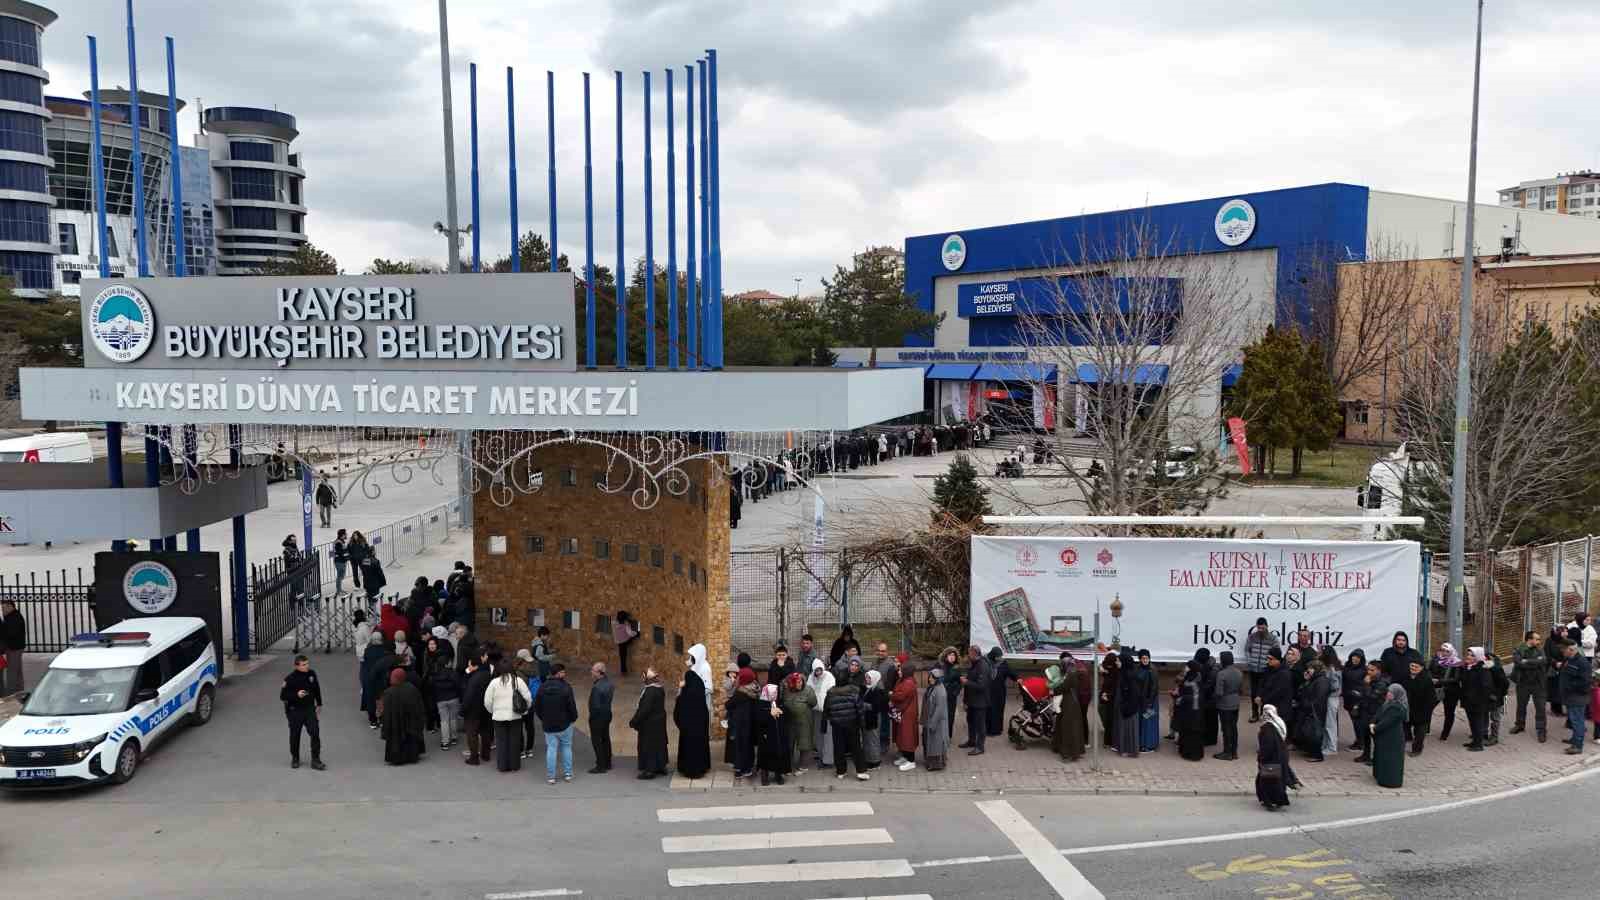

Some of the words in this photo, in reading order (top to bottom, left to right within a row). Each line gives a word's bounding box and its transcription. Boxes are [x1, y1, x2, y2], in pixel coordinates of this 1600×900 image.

[277, 287, 416, 321] KAYSERİ
[164, 325, 366, 367] BÜYÜKŞEHİR
[376, 325, 563, 361] BELEDİYESİ
[115, 377, 228, 410] KAYSERİ
[236, 376, 342, 413] DÜNYA
[353, 378, 477, 414] TİCARET
[487, 379, 638, 416] MERKEZİ
[1209, 551, 1271, 570] KUTSAL
[1292, 552, 1338, 570] VAKIF
[1169, 569, 1270, 588] EMANETLER
[1275, 565, 1288, 576] VE
[1291, 570, 1372, 590] ESERLERİ
[1229, 591, 1306, 610] SERGİSİ
[1193, 624, 1237, 649] Hoş
[1248, 621, 1344, 647] ldniz
[150, 703, 169, 728] POLİS
[24, 726, 71, 735] POLİS
